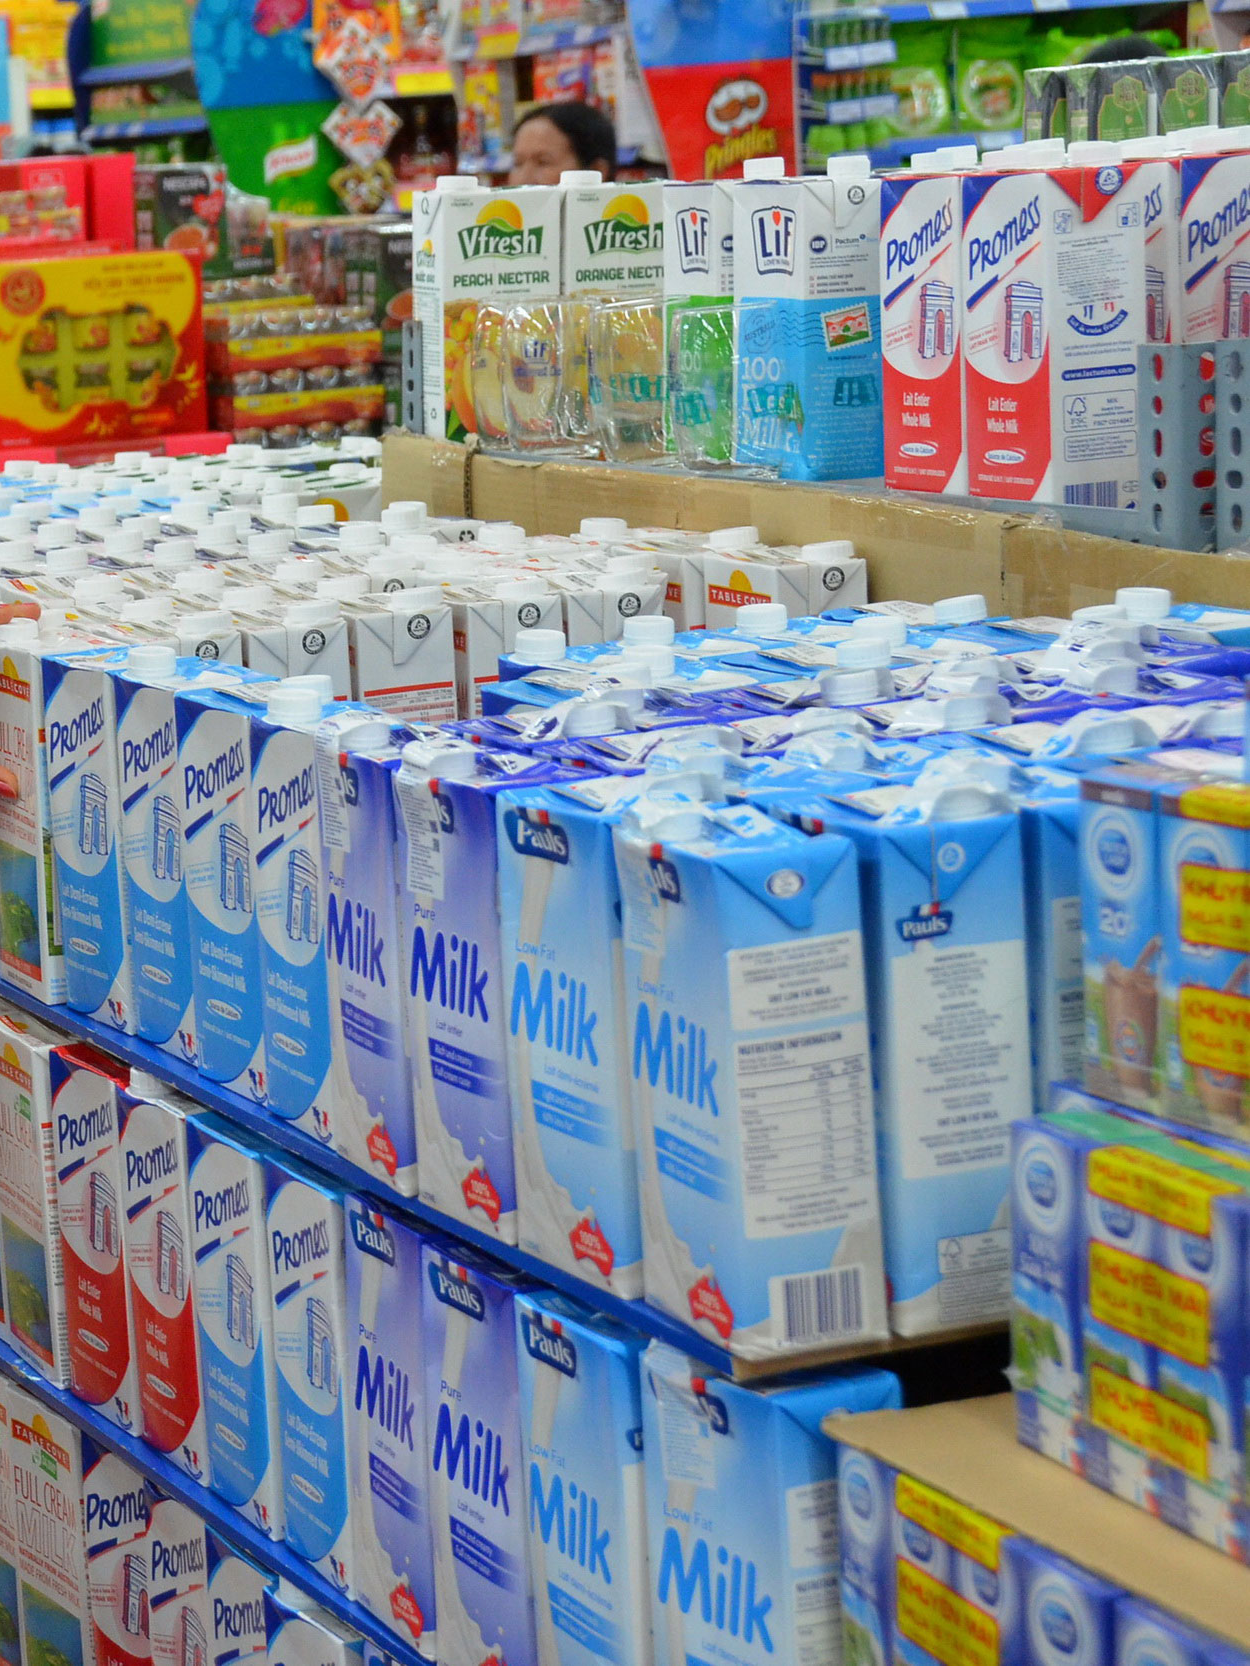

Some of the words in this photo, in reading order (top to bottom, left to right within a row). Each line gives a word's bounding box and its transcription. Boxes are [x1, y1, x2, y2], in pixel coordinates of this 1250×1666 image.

[704, 127, 778, 178] Pringles
[461, 226, 537, 256] Vfresh
[588, 219, 663, 253] Vfresh
[758, 210, 792, 258] LiF
[886, 197, 952, 280] Promess
[968, 194, 1041, 281] Promess
[453, 273, 493, 288] PEACH
[498, 270, 550, 285] NECTAR
[576, 267, 626, 282] ORANGE
[523, 340, 548, 360] LiF
[903, 392, 914, 407] Lait
[914, 392, 931, 408] Entier
[988, 396, 999, 412] Lait
[1000, 397, 1018, 413] Entier
[902, 412, 918, 427] Whole
[919, 413, 932, 428] Milk
[986, 418, 1004, 434] Whole
[1005, 418, 1019, 434] Milk
[712, 589, 742, 604] TABLE
[13, 680, 31, 698] COVE
[184, 738, 245, 810] Promess
[517, 818, 566, 857] Pauls
[328, 871, 346, 889] Pure
[414, 903, 436, 921] Pure
[902, 914, 949, 938] Pauls
[327, 892, 387, 988] Milk
[515, 937, 539, 955] Low
[540, 942, 556, 962] Fat
[410, 926, 489, 1024] Milk
[636, 975, 657, 996] Low
[510, 961, 599, 1068] Milk
[633, 1002, 720, 1118] Milk
[739, 1040, 784, 1055] NUTRITION
[786, 1031, 842, 1049] INFORMATION
[14, 1066, 32, 1088] COVE
[469, 1178, 491, 1195] 100%
[194, 1177, 249, 1233] Promess
[272, 1219, 330, 1275] Promess
[356, 1219, 393, 1259] Pauls
[578, 1228, 602, 1250] 100%
[438, 1271, 482, 1313] Pauls
[358, 1323, 378, 1344] Pure
[529, 1326, 573, 1370] Pauls
[355, 1345, 414, 1452] Milk
[440, 1379, 462, 1402] Pure
[14, 1423, 45, 1447] TABLE
[45, 1440, 69, 1465] COVE
[433, 1403, 510, 1518] Milk
[528, 1440, 549, 1461] Low
[550, 1448, 566, 1470] Fat
[14, 1465, 42, 1508] FULL
[43, 1482, 78, 1532] CREAM
[86, 1488, 147, 1533] Prome
[530, 1462, 612, 1585] Milk
[663, 1502, 690, 1523] Low
[692, 1510, 715, 1534] Fat
[15, 1499, 79, 1581] MILK
[152, 1537, 204, 1581] Promess
[658, 1527, 774, 1654] Milk
